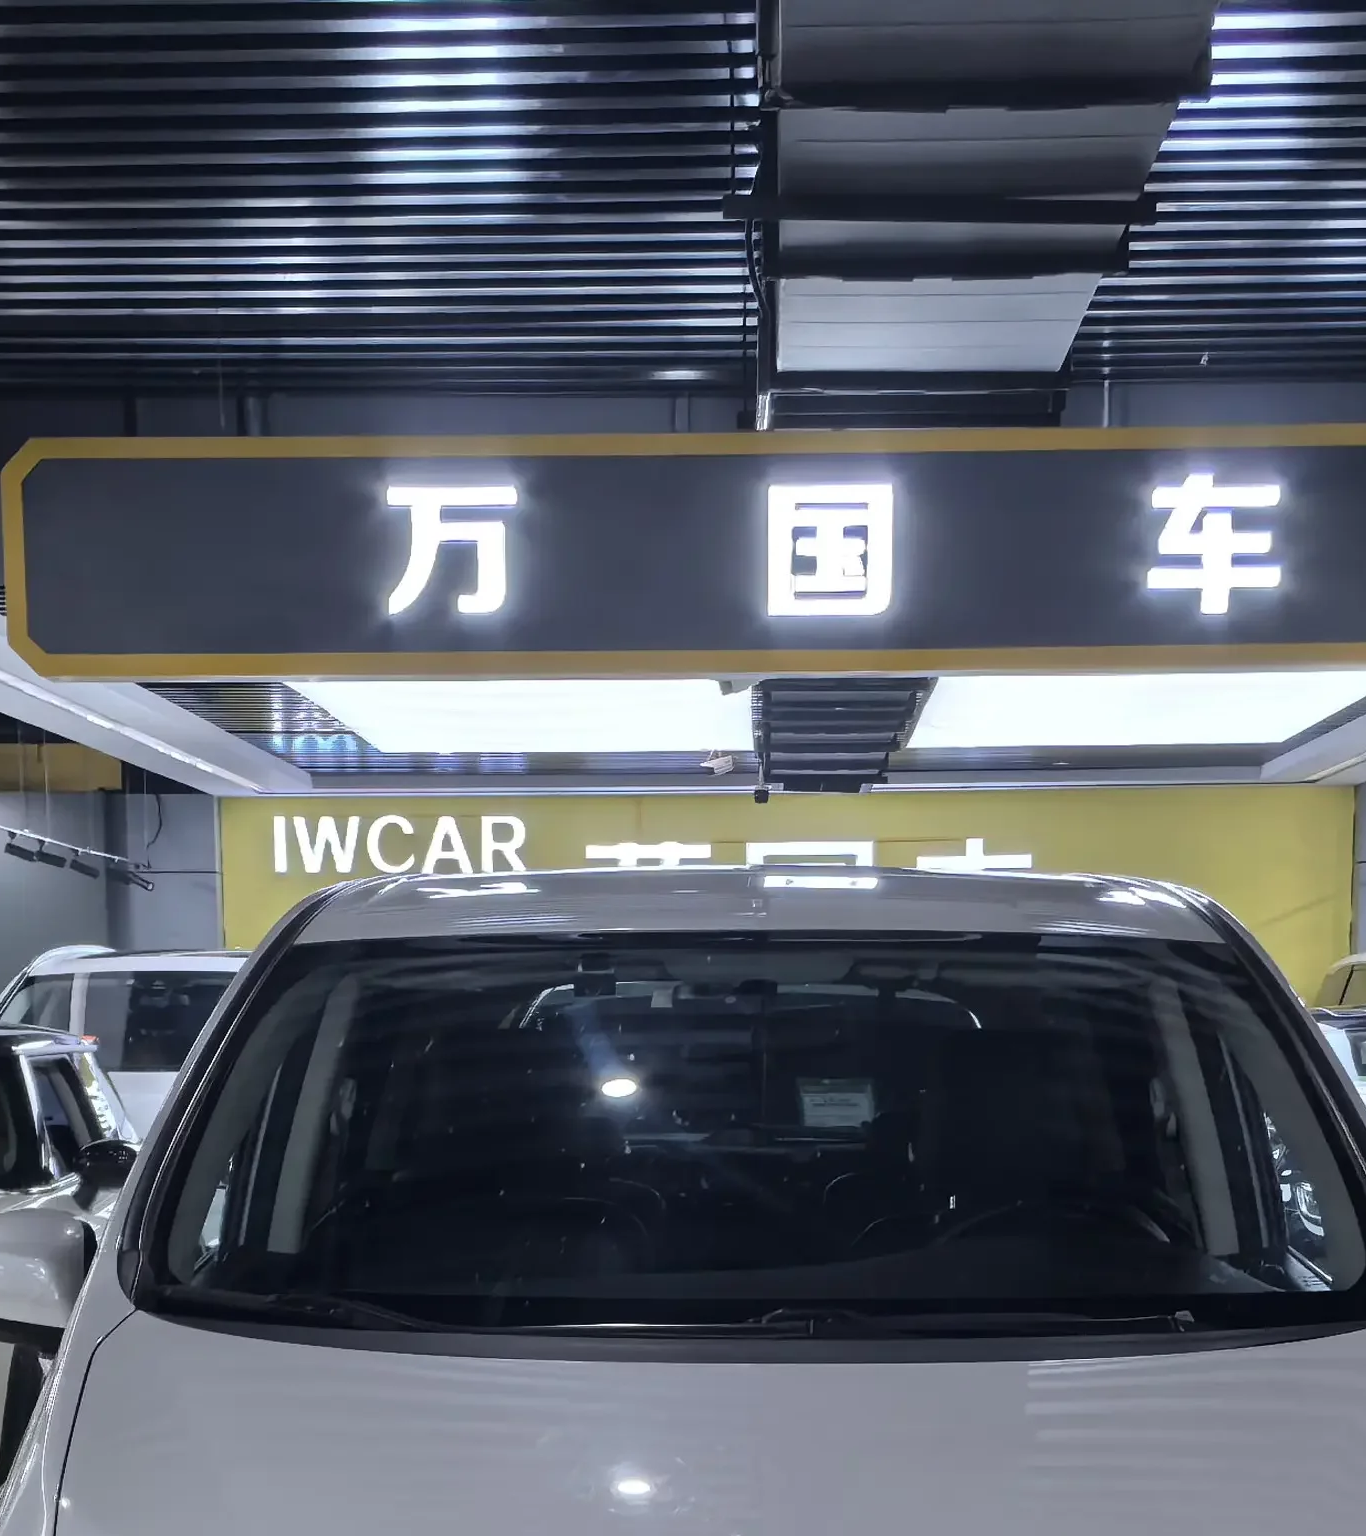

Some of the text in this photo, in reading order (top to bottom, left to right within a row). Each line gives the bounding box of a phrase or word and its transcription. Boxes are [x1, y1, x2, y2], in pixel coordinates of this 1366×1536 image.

[387, 474, 1281, 616] 万国车
[272, 814, 527, 874] IWCAR
